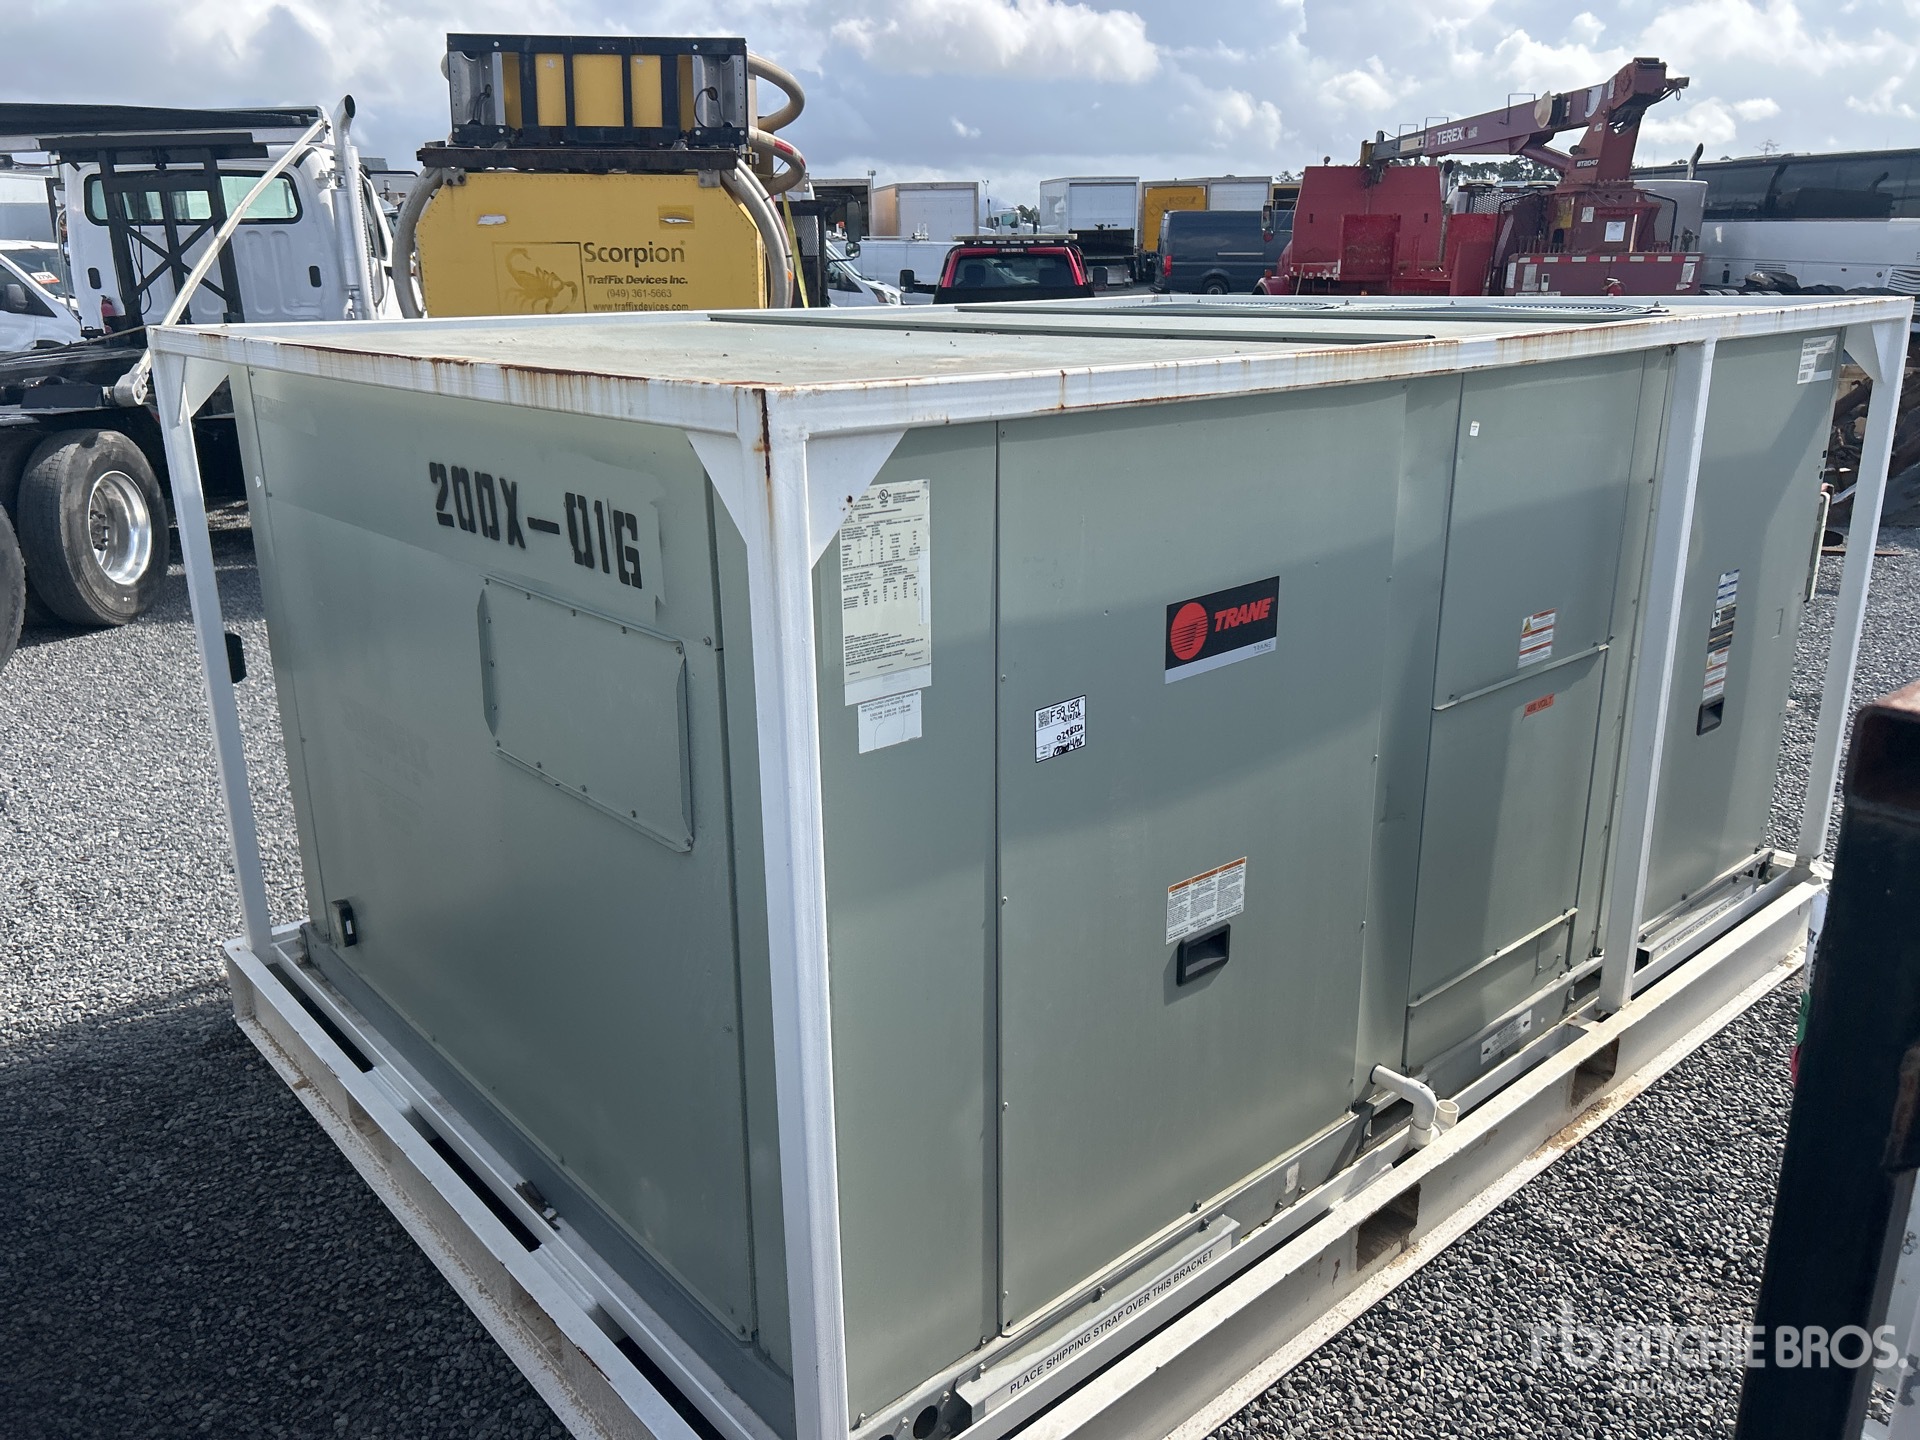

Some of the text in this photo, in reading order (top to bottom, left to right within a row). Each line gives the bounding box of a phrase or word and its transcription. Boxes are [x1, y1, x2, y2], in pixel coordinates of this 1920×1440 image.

[1436, 126, 1463, 145] TEREX
[583, 241, 685, 267] Scorpion
[587, 275, 689, 285] TrafFix Devices Inc.
[606, 288, 672, 299] (949) 361-5663
[593, 302, 689, 312] www.traffixdevices.com
[1214, 597, 1272, 632] TRANE
[1010, 1249, 1214, 1394] PLACE SHIPPING STRAP OVER THIS BRACKET
